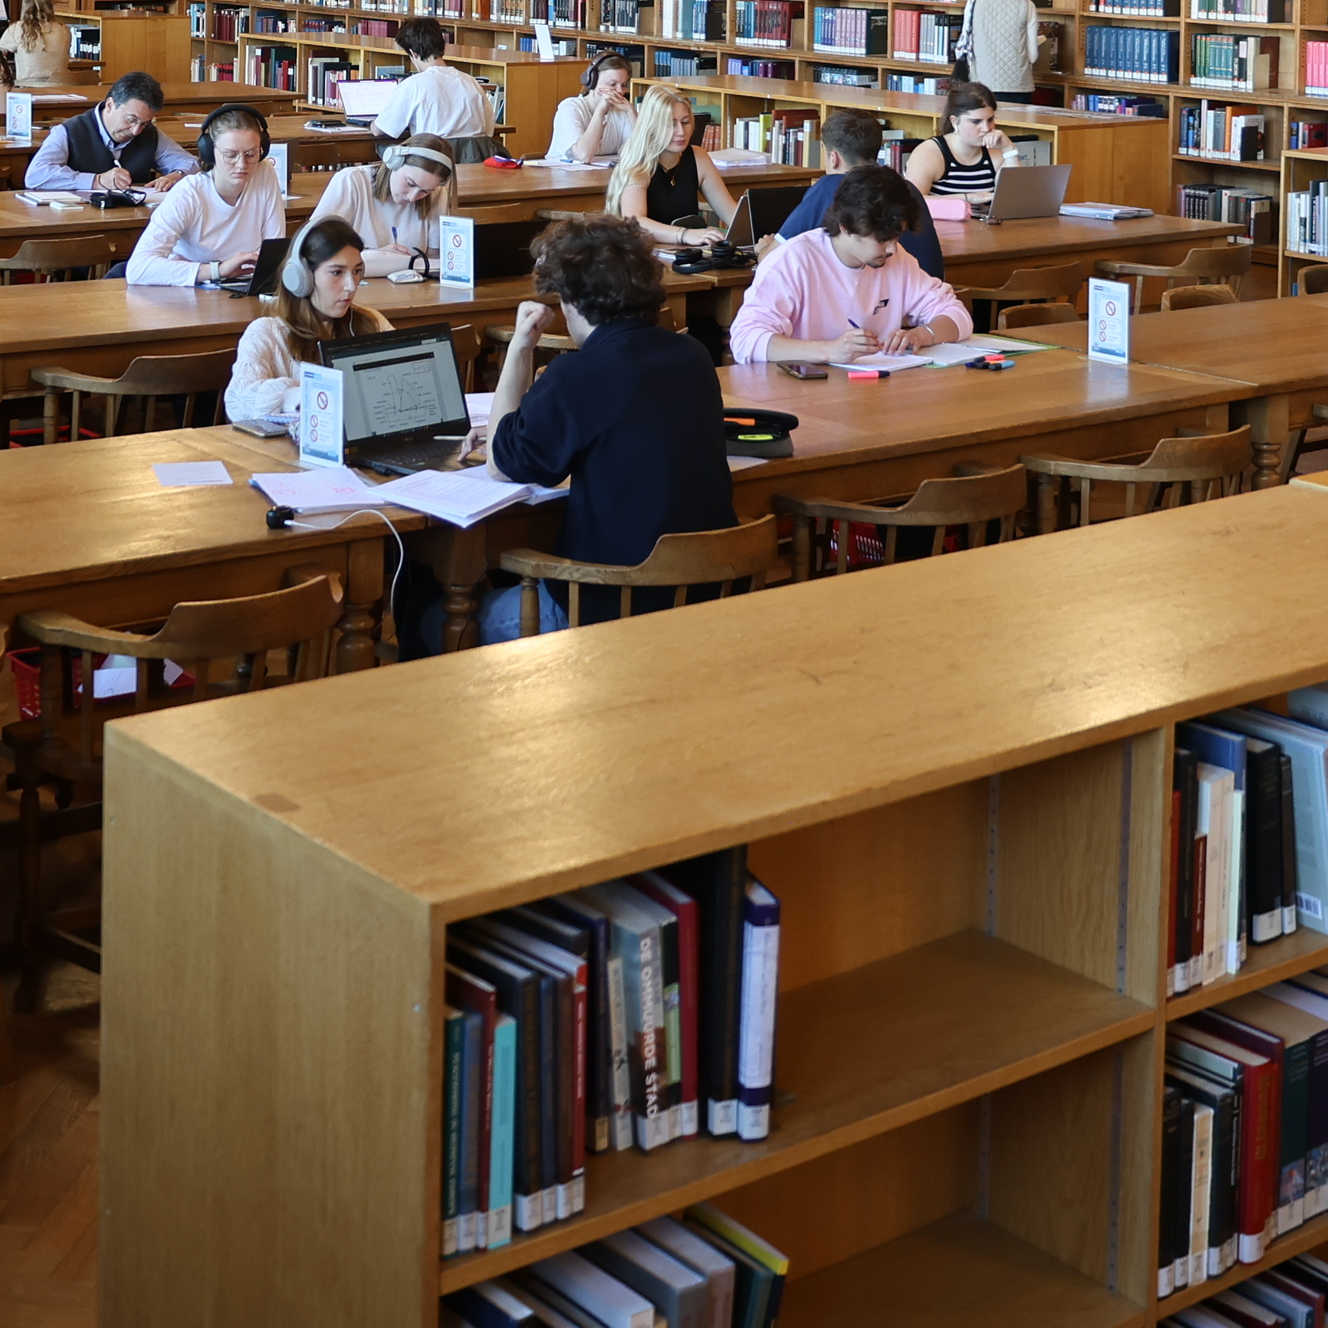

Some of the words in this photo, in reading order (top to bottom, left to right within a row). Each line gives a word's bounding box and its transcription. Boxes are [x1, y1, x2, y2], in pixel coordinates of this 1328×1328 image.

[640, 936, 653, 962] DE
[641, 969, 657, 1071] OMMUURDE
[645, 1074, 659, 1120] STAD
